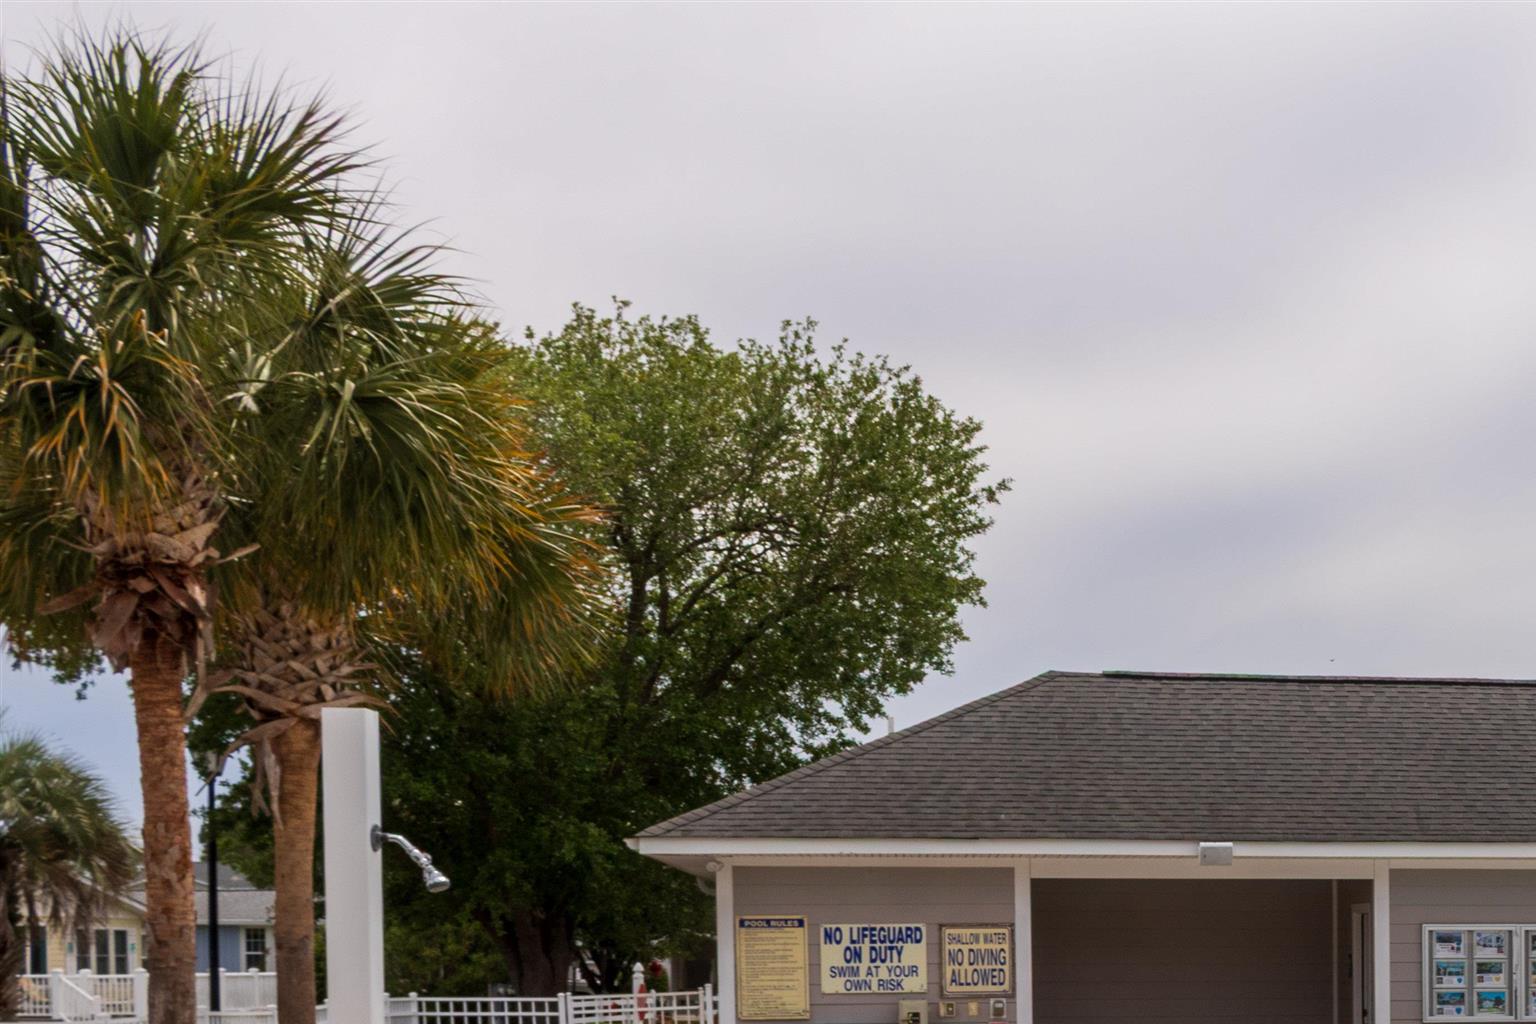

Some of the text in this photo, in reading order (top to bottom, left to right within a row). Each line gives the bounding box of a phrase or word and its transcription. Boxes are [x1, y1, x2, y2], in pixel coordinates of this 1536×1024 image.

[824, 927, 922, 944] NO LIFEGUARD
[948, 933, 1006, 945] SHALLOW WATER
[844, 946, 904, 964] ON DUTY
[948, 949, 1006, 966] NO DIVING
[829, 965, 919, 978] SWIM AT YOUR
[950, 968, 1005, 986] ALLOWED
[844, 979, 904, 991] OWN RISK
